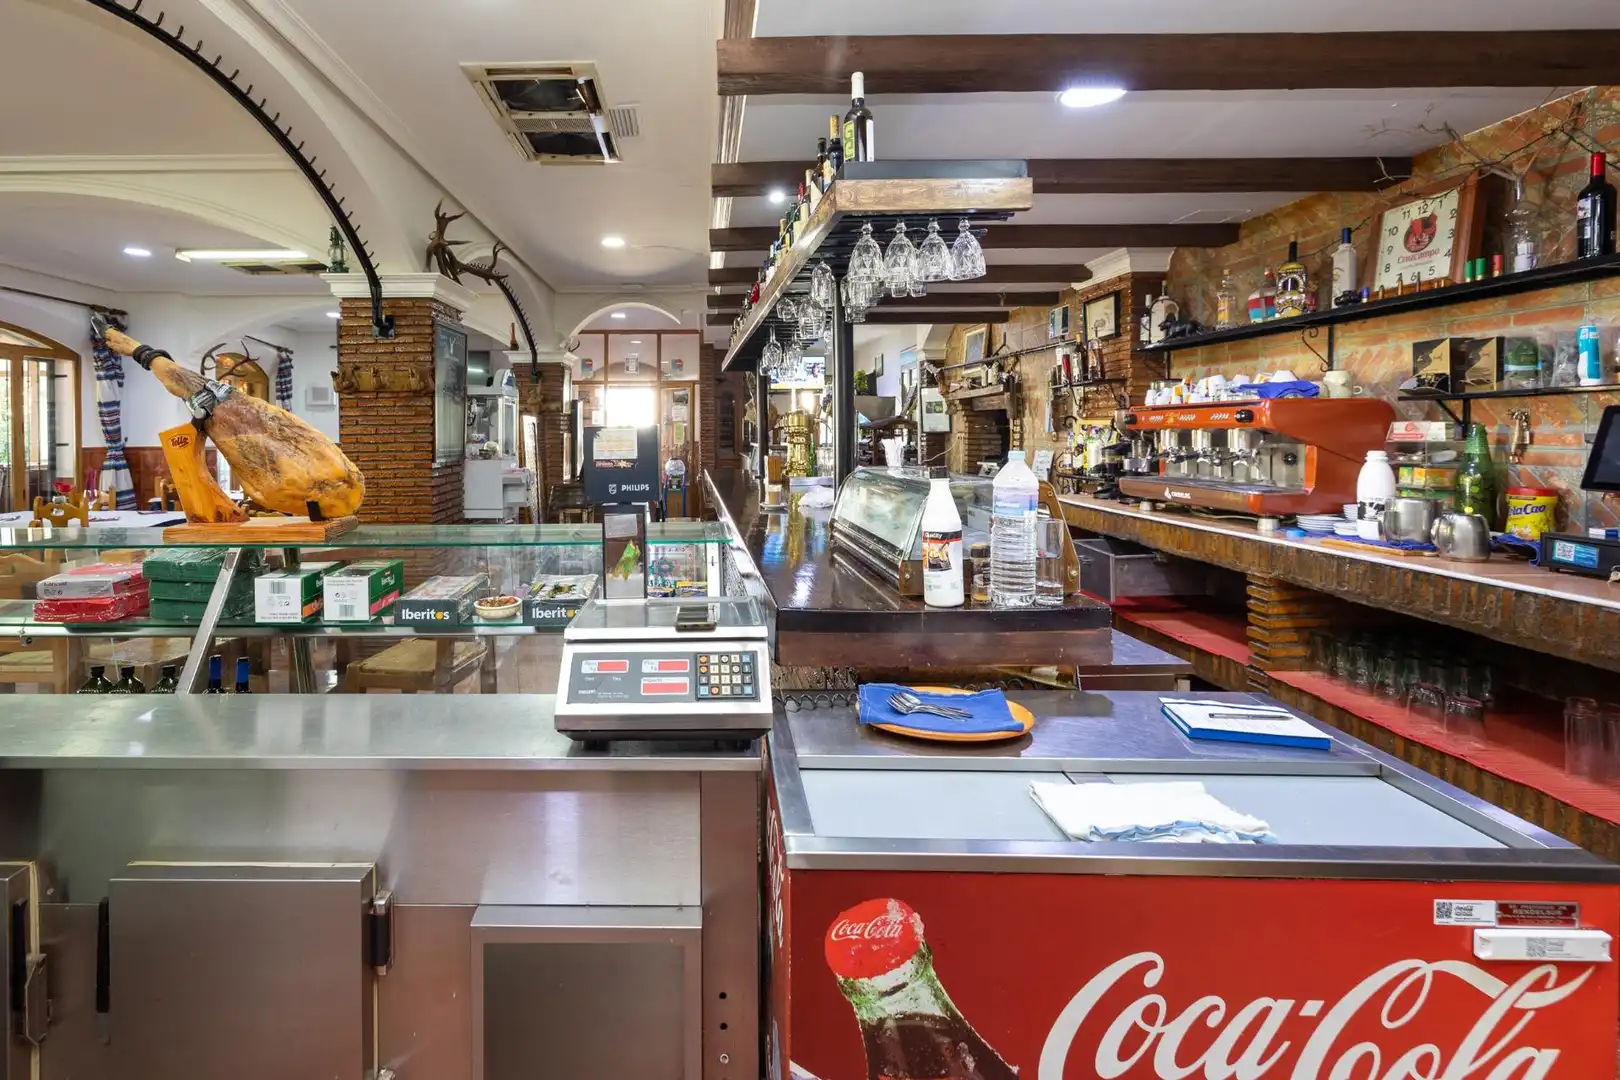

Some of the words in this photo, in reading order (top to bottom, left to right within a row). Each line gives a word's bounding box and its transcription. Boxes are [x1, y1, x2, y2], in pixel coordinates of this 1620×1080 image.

[1401, 209, 1412, 220] 11
[1417, 203, 1429, 215] 12
[1450, 208, 1457, 219] 2
[1387, 226, 1399, 238] 10
[1447, 229, 1455, 239] 3
[1386, 245, 1394, 255] 9
[1444, 248, 1452, 257] 4
[1397, 248, 1440, 264] Cruzcampo
[1384, 263, 1391, 273] 8
[1428, 265, 1436, 276] 5
[1410, 271, 1418, 281] 6
[621, 483, 651, 492] PHILIPS
[401, 607, 450, 621] Iberitos
[831, 915, 904, 941] Coca-Cola
